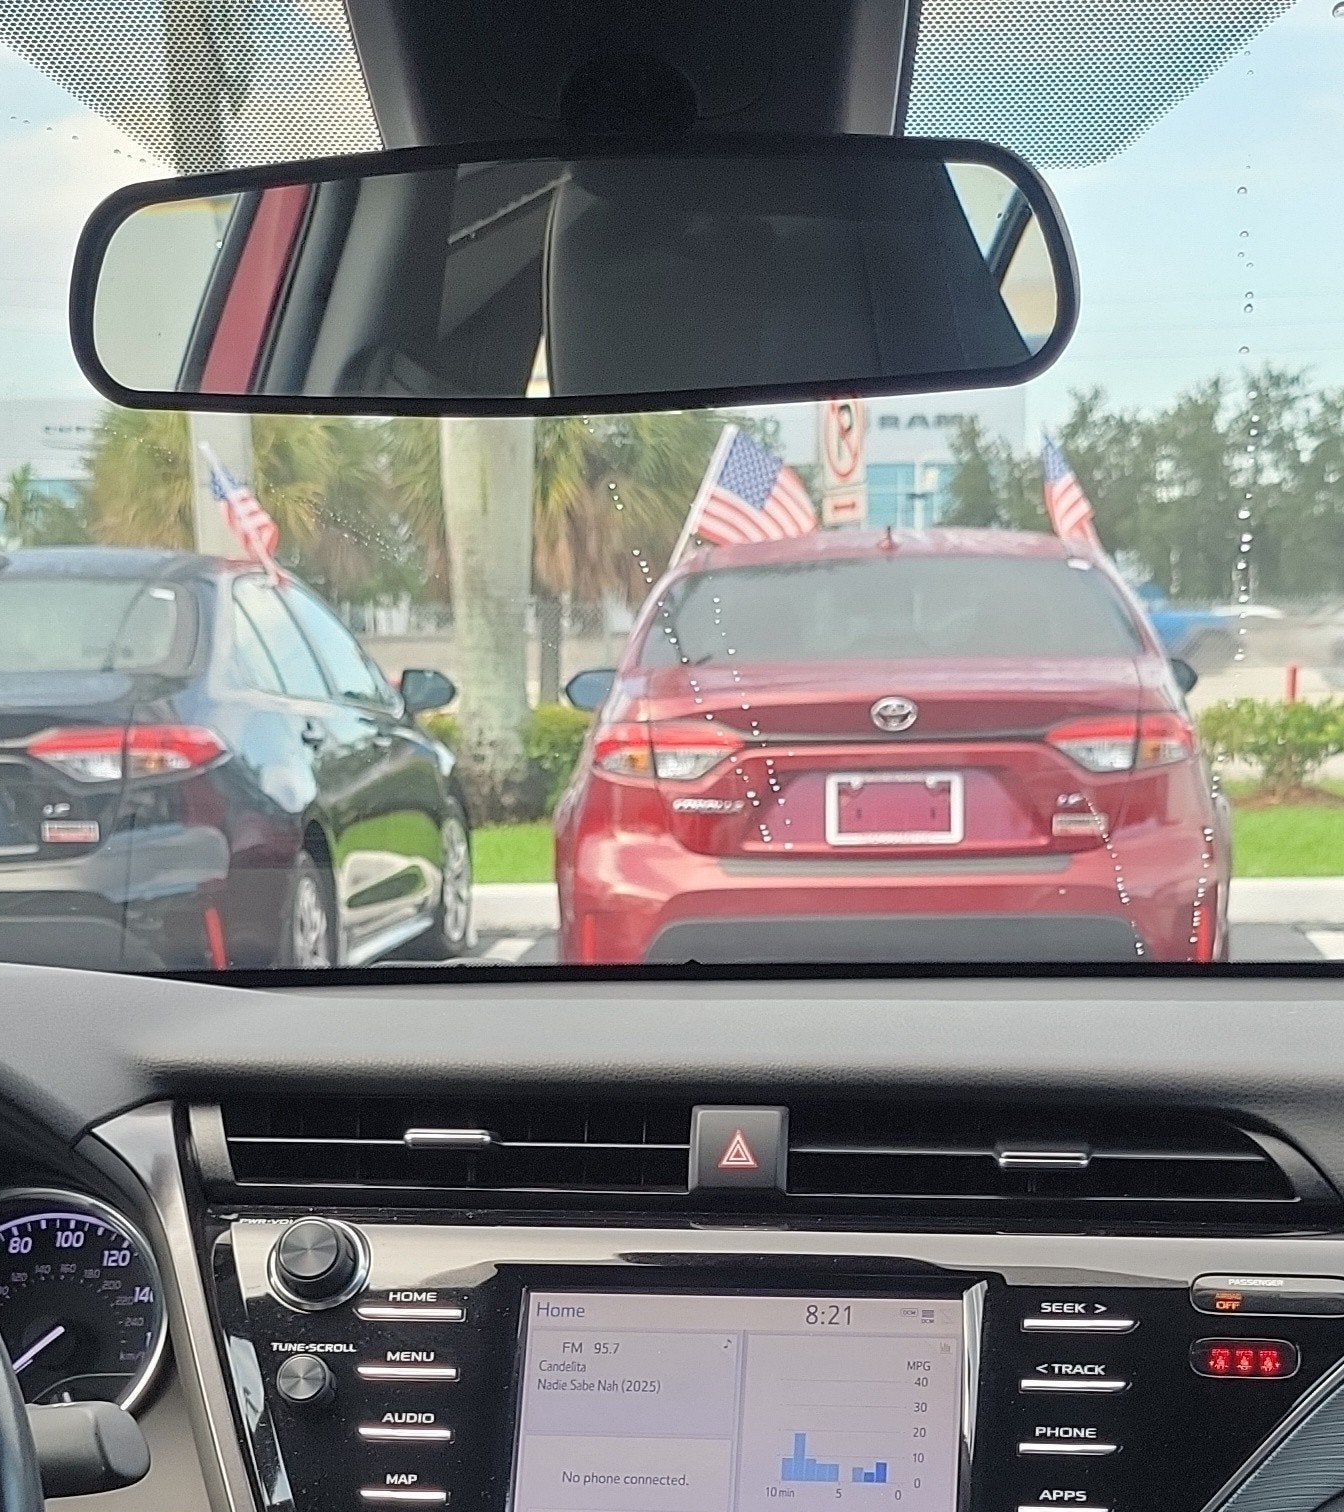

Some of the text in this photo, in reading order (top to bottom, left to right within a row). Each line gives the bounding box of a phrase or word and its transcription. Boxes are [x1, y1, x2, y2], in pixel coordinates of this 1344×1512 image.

[55, 1231, 85, 1248] 100
[8, 1237, 32, 1254] 80
[102, 1250, 130, 1267] 120
[1228, 1278, 1284, 1287] PASSENGER
[388, 1291, 438, 1302] HOME
[536, 1302, 585, 1317] Home
[1040, 1302, 1086, 1314] SEEK
[1215, 1301, 1241, 1310] OFF
[806, 1304, 852, 1325] 8:21
[562, 1342, 620, 1354] FM 95.7
[386, 1351, 435, 1362] MENU
[539, 1360, 587, 1373] Candelita
[907, 1361, 931, 1372] MPG
[1051, 1364, 1106, 1375] TRACK
[537, 1378, 568, 1391] Nadie
[570, 1379, 595, 1392] Sabe
[621, 1380, 661, 1394] (2025)
[914, 1377, 929, 1388] 40
[913, 1402, 928, 1413] 30
[382, 1413, 435, 1424] AUDIO
[913, 1427, 927, 1438] 20
[1035, 1426, 1097, 1439] PHONE
[912, 1453, 925, 1463] 10
[385, 1474, 418, 1485] MAP
[562, 1471, 690, 1486] No phone connected.
[914, 1478, 921, 1489] 0
[765, 1487, 795, 1498] 10 min
[835, 1488, 842, 1499] 5
[894, 1489, 902, 1500] 0
[1039, 1490, 1087, 1502] APPS
